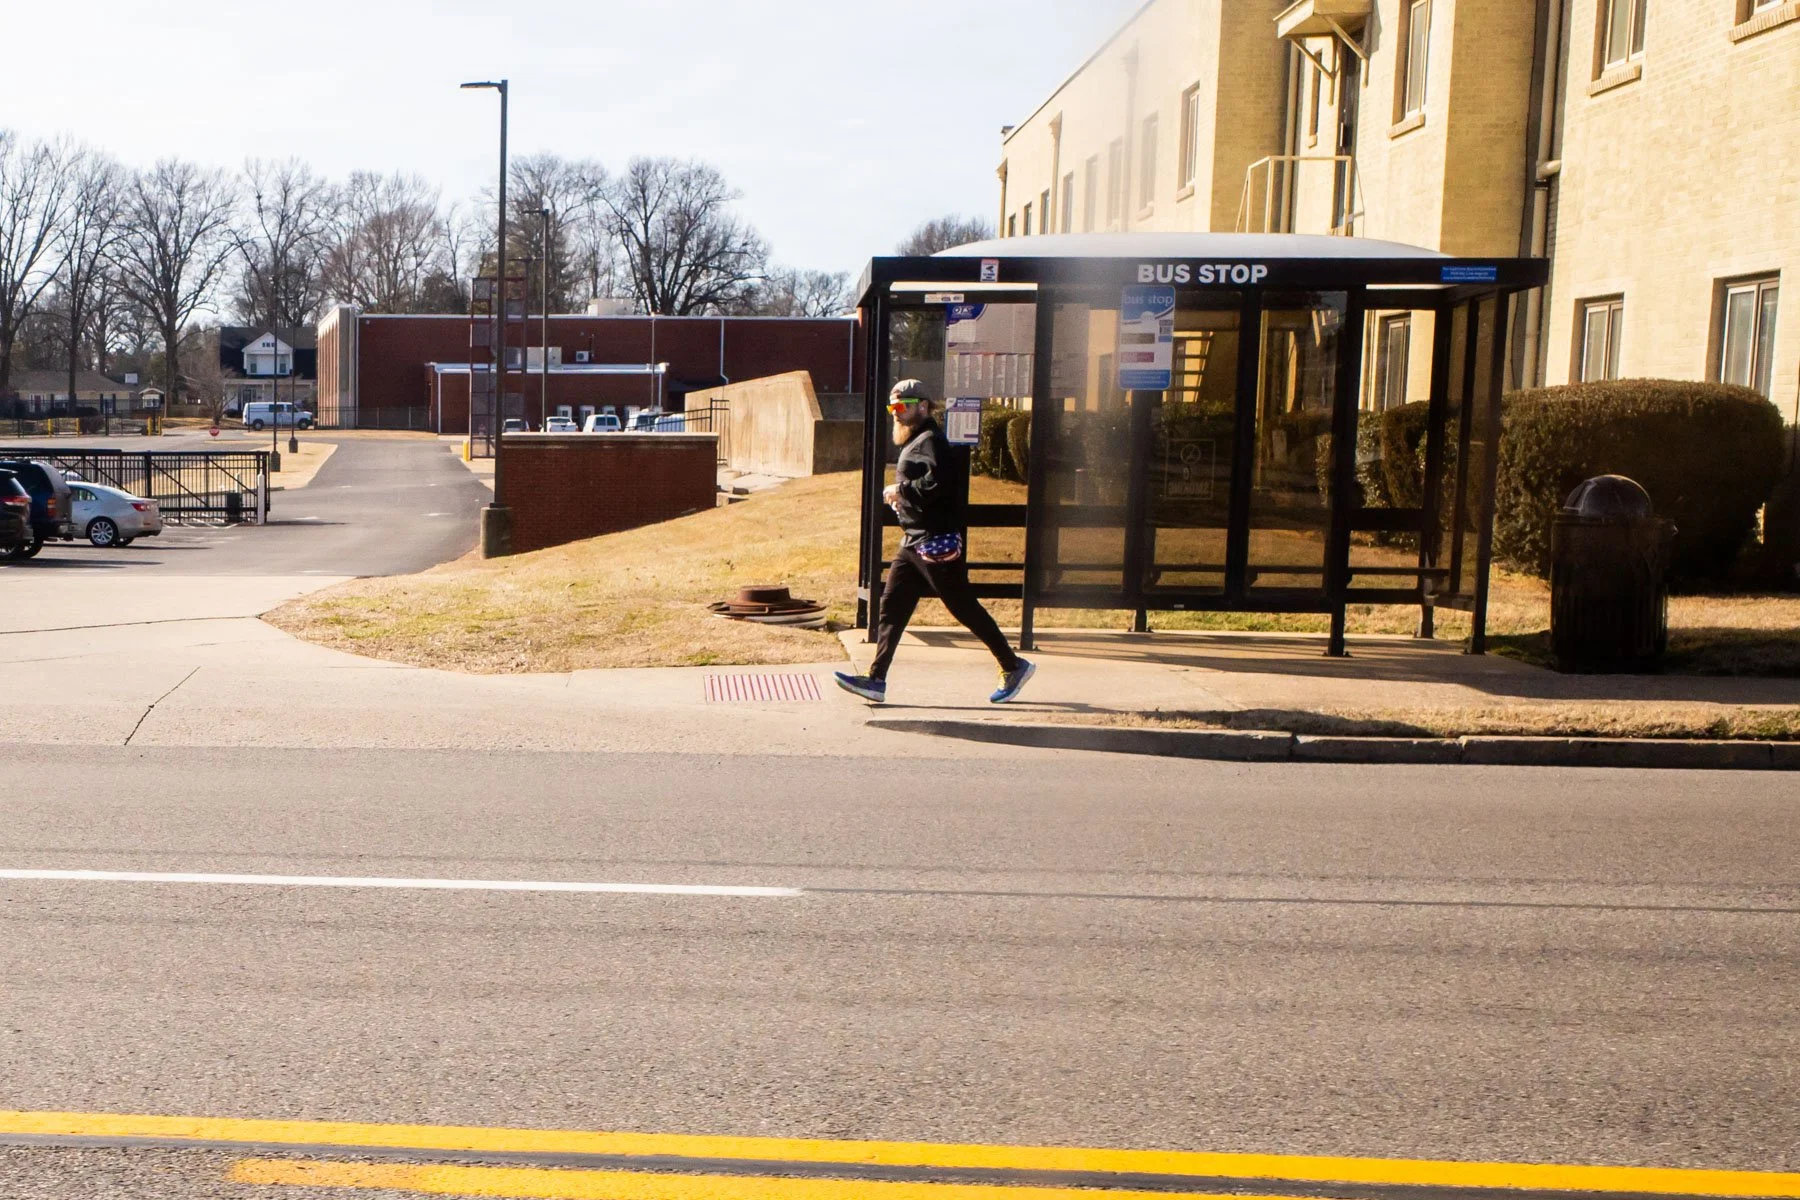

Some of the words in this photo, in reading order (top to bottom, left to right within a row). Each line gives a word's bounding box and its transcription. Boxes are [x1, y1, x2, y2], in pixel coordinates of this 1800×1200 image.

[1137, 264, 1190, 283] BUS
[1198, 264, 1268, 284] STOP
[1123, 293, 1144, 305] bus
[1147, 293, 1173, 307] stop
